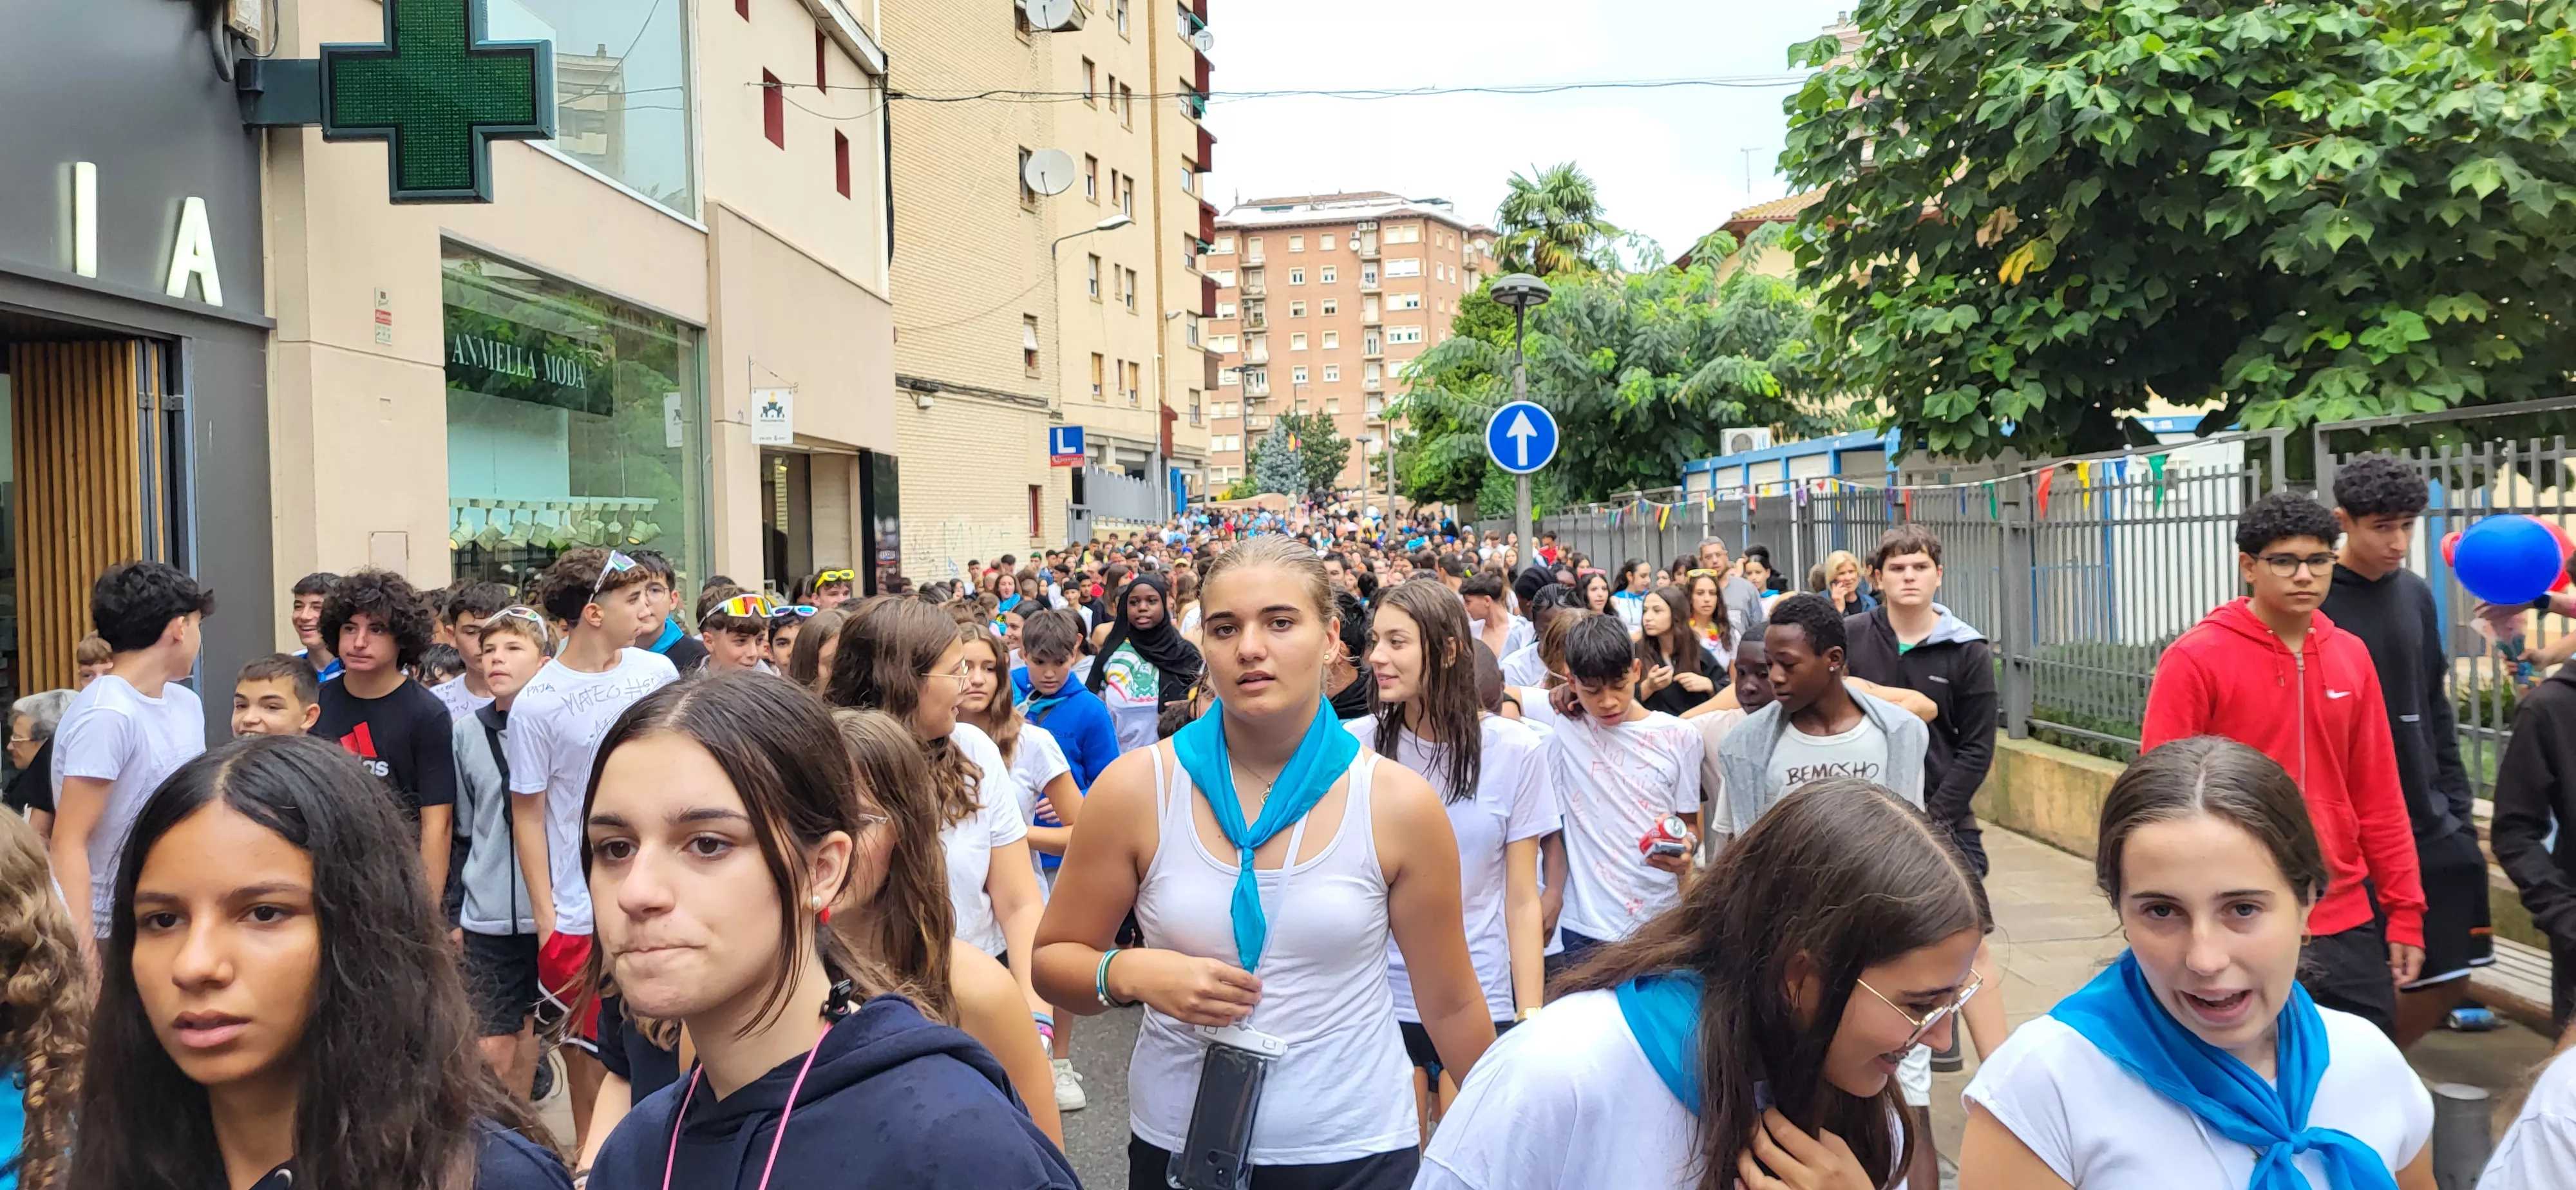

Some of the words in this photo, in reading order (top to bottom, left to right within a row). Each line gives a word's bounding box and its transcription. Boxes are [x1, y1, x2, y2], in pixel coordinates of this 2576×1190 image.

[452, 332, 538, 379] ANMELLA
[543, 352, 585, 389] MODA
[1057, 428, 1077, 454] L
[561, 684, 621, 717] MATEO
